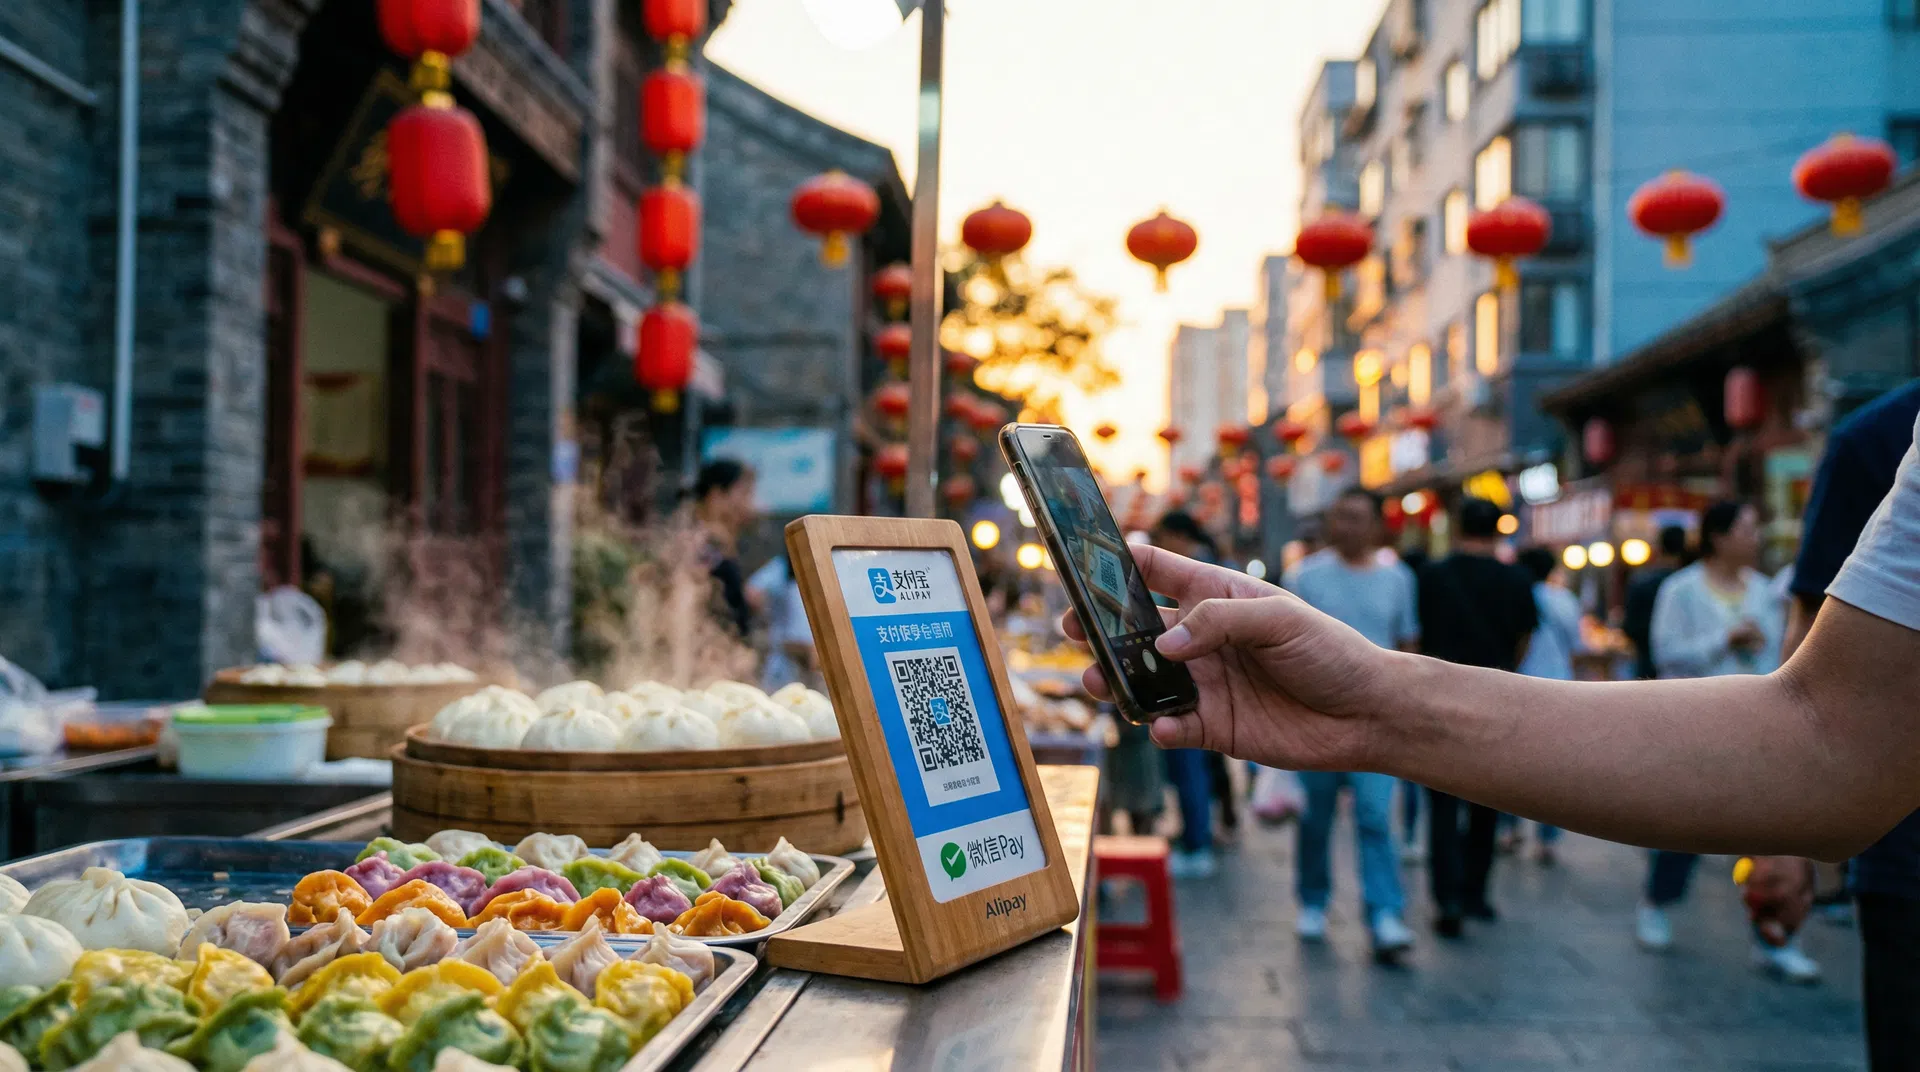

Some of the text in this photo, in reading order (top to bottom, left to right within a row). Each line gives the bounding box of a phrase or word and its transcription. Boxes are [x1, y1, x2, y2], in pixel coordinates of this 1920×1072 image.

[892, 569, 930, 590] 支付宝
[900, 590, 931, 601] ALIPAY
[967, 834, 1024, 869] 微信Pay
[986, 893, 1026, 919] Alipay
